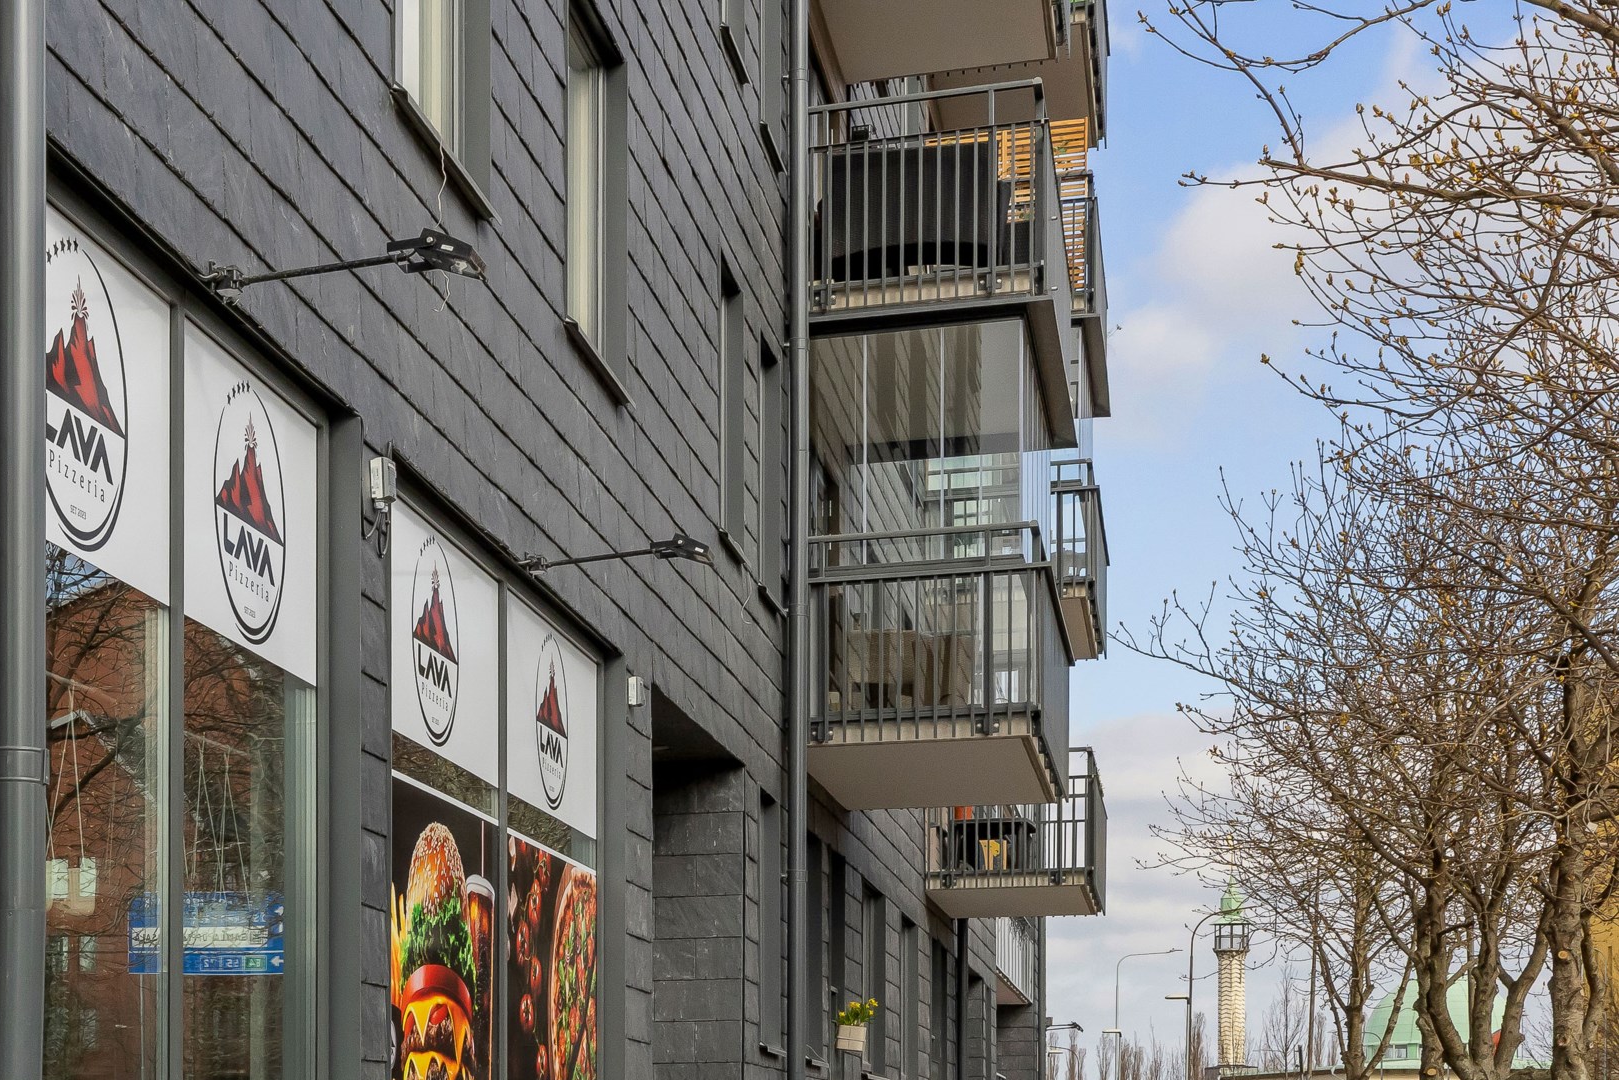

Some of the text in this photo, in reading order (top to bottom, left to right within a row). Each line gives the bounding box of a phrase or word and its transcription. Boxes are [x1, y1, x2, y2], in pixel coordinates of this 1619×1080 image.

[49, 449, 105, 503] Pizzeria
[223, 511, 276, 588] LAVA
[229, 560, 269, 602] Pizzeria
[418, 642, 452, 699] LAVA
[540, 724, 564, 769] LAVA
